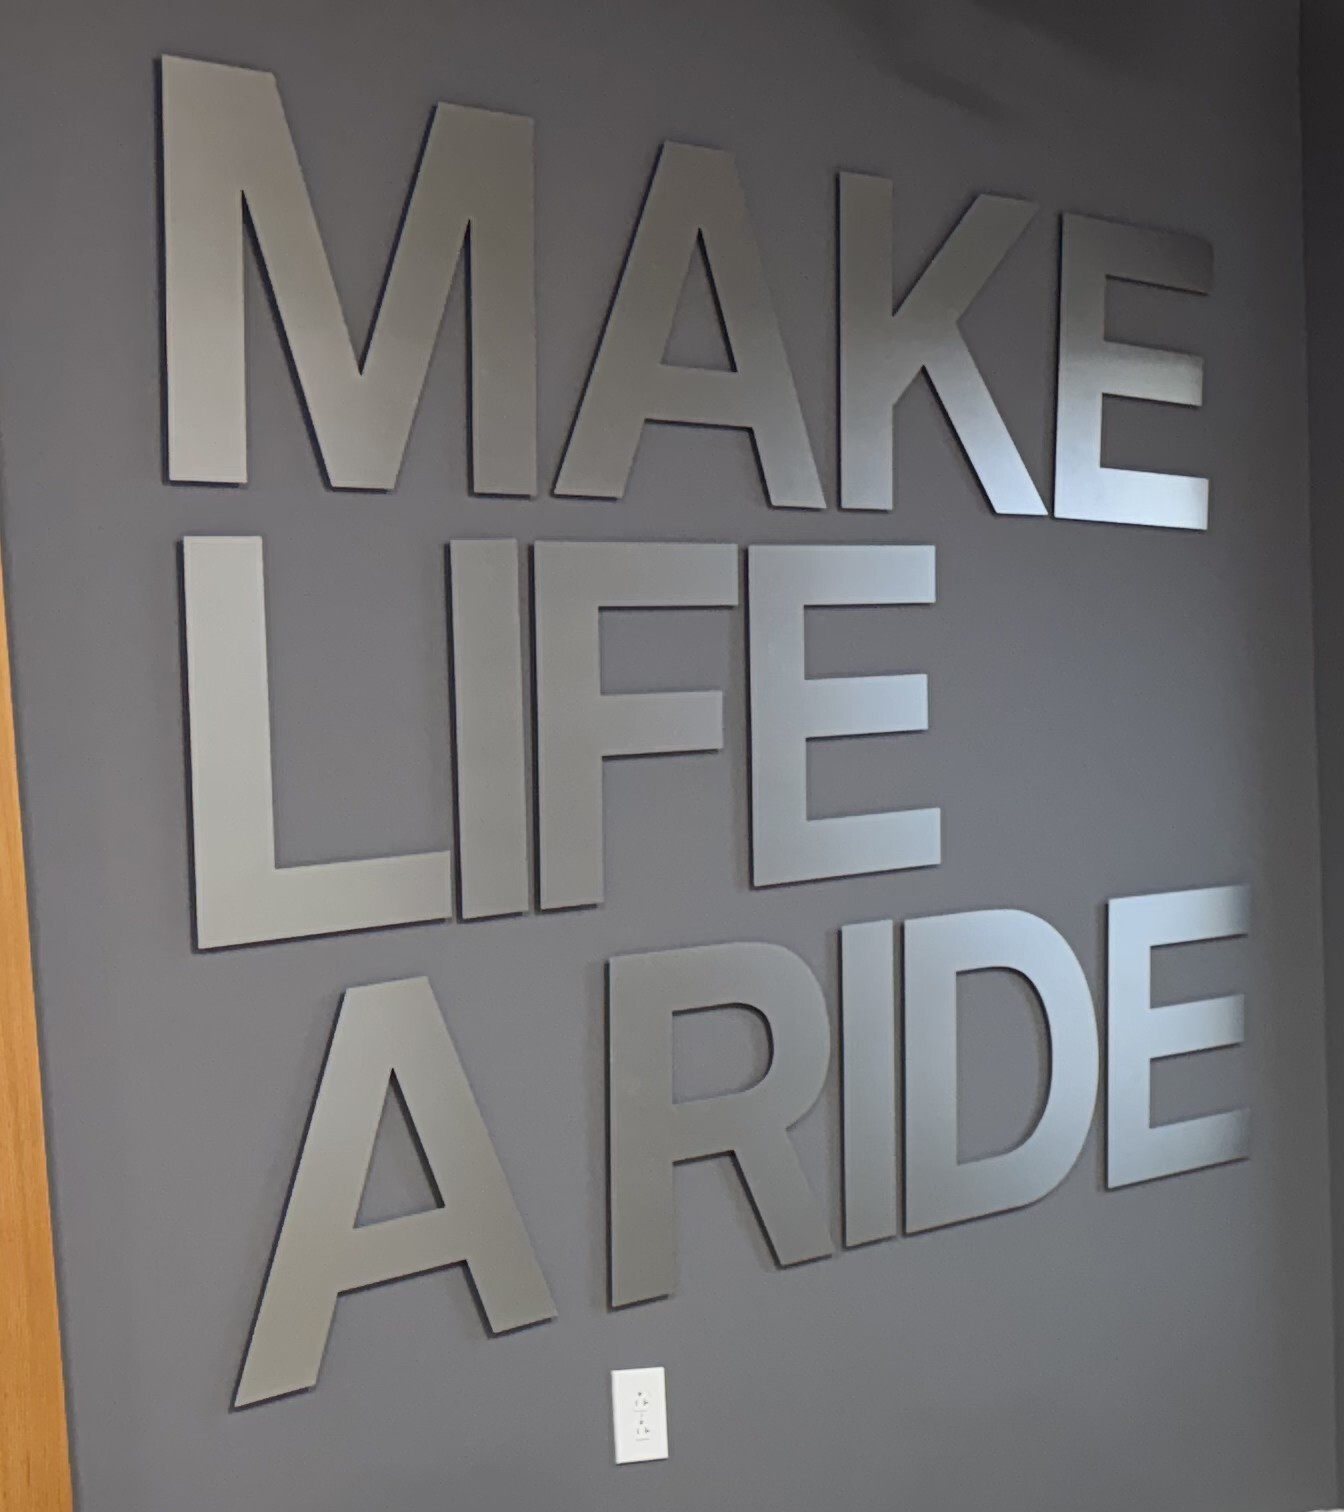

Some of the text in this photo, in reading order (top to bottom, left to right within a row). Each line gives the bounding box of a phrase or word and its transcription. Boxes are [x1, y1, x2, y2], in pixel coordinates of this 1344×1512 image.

[162, 54, 1213, 530] MAKE
[181, 535, 941, 950] LIFE
[234, 886, 1251, 1409] A RIDE
